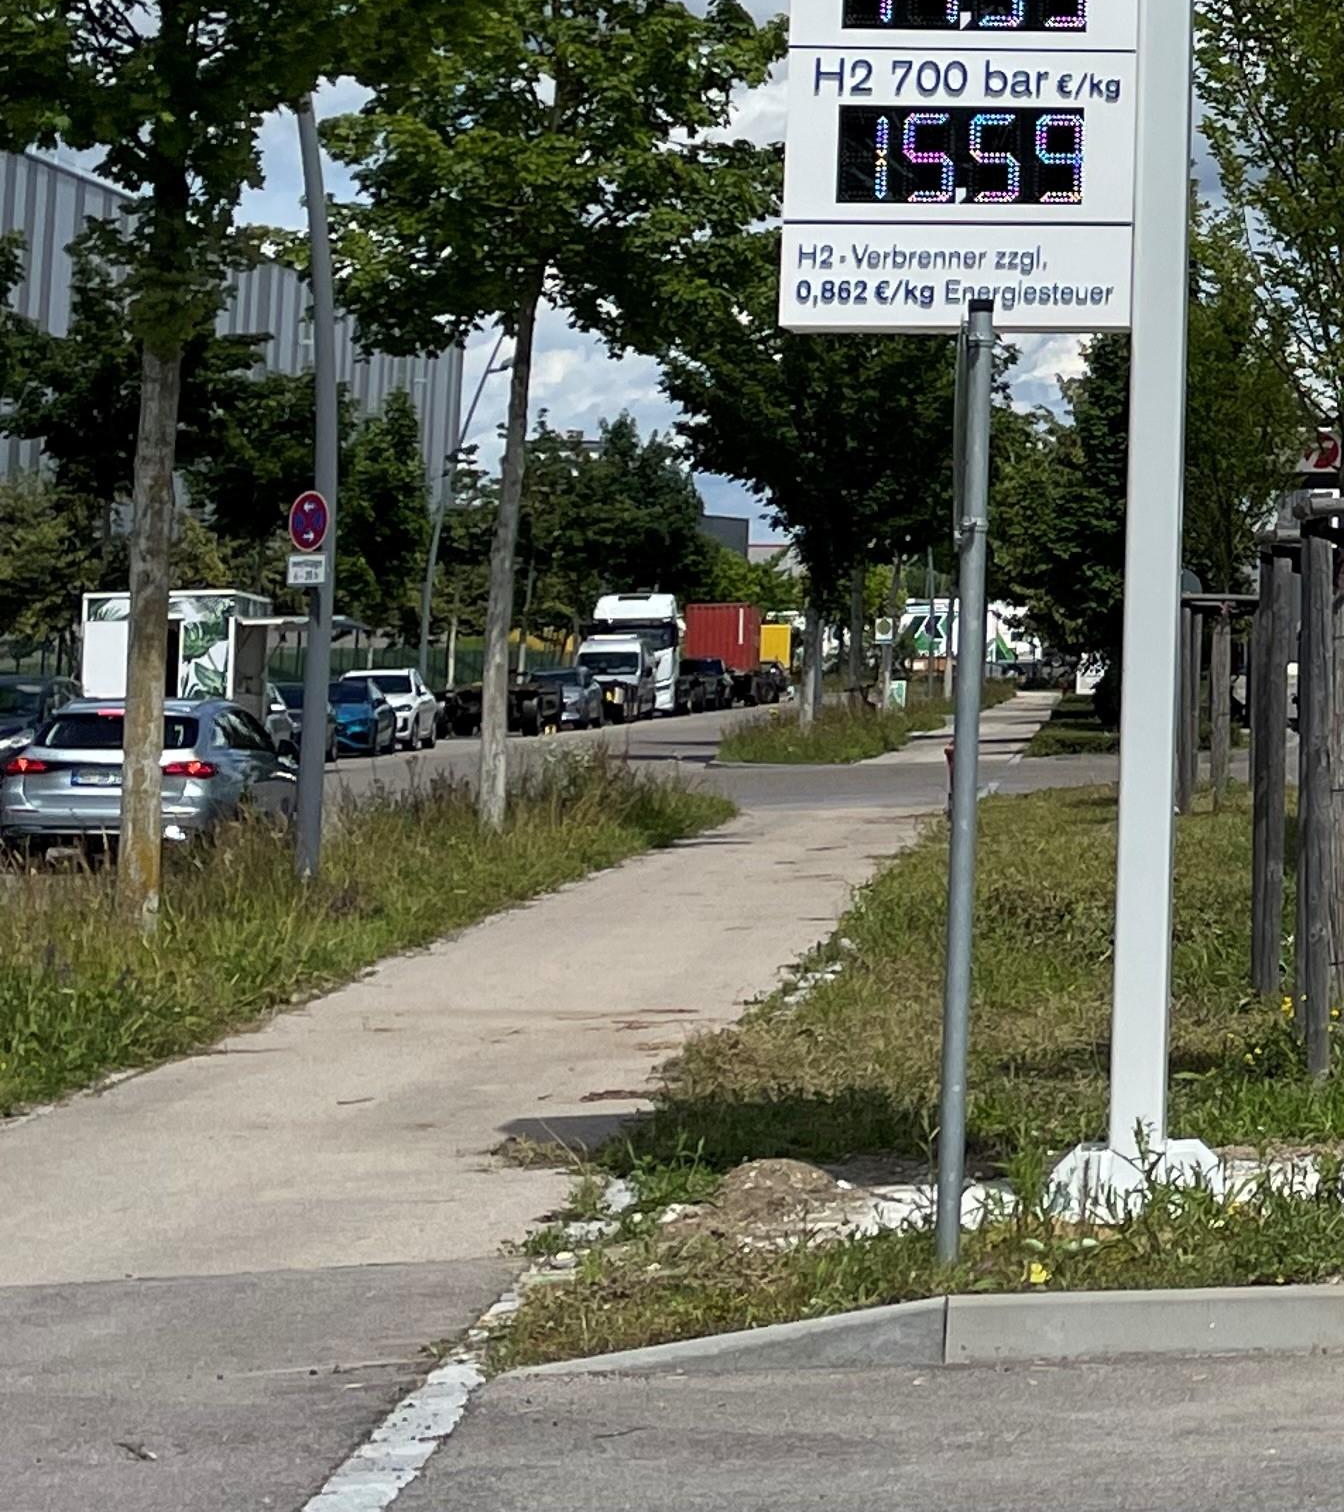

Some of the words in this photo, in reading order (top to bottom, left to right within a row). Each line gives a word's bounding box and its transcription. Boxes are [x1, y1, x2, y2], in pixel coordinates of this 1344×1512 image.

[813, 57, 873, 97] H2
[891, 60, 968, 98] 700
[983, 59, 1049, 99] bar
[1056, 72, 1121, 103] €/kg
[796, 279, 868, 308] 0,862
[874, 279, 935, 309] €/kg
[945, 279, 1115, 310] Energiesteuer
